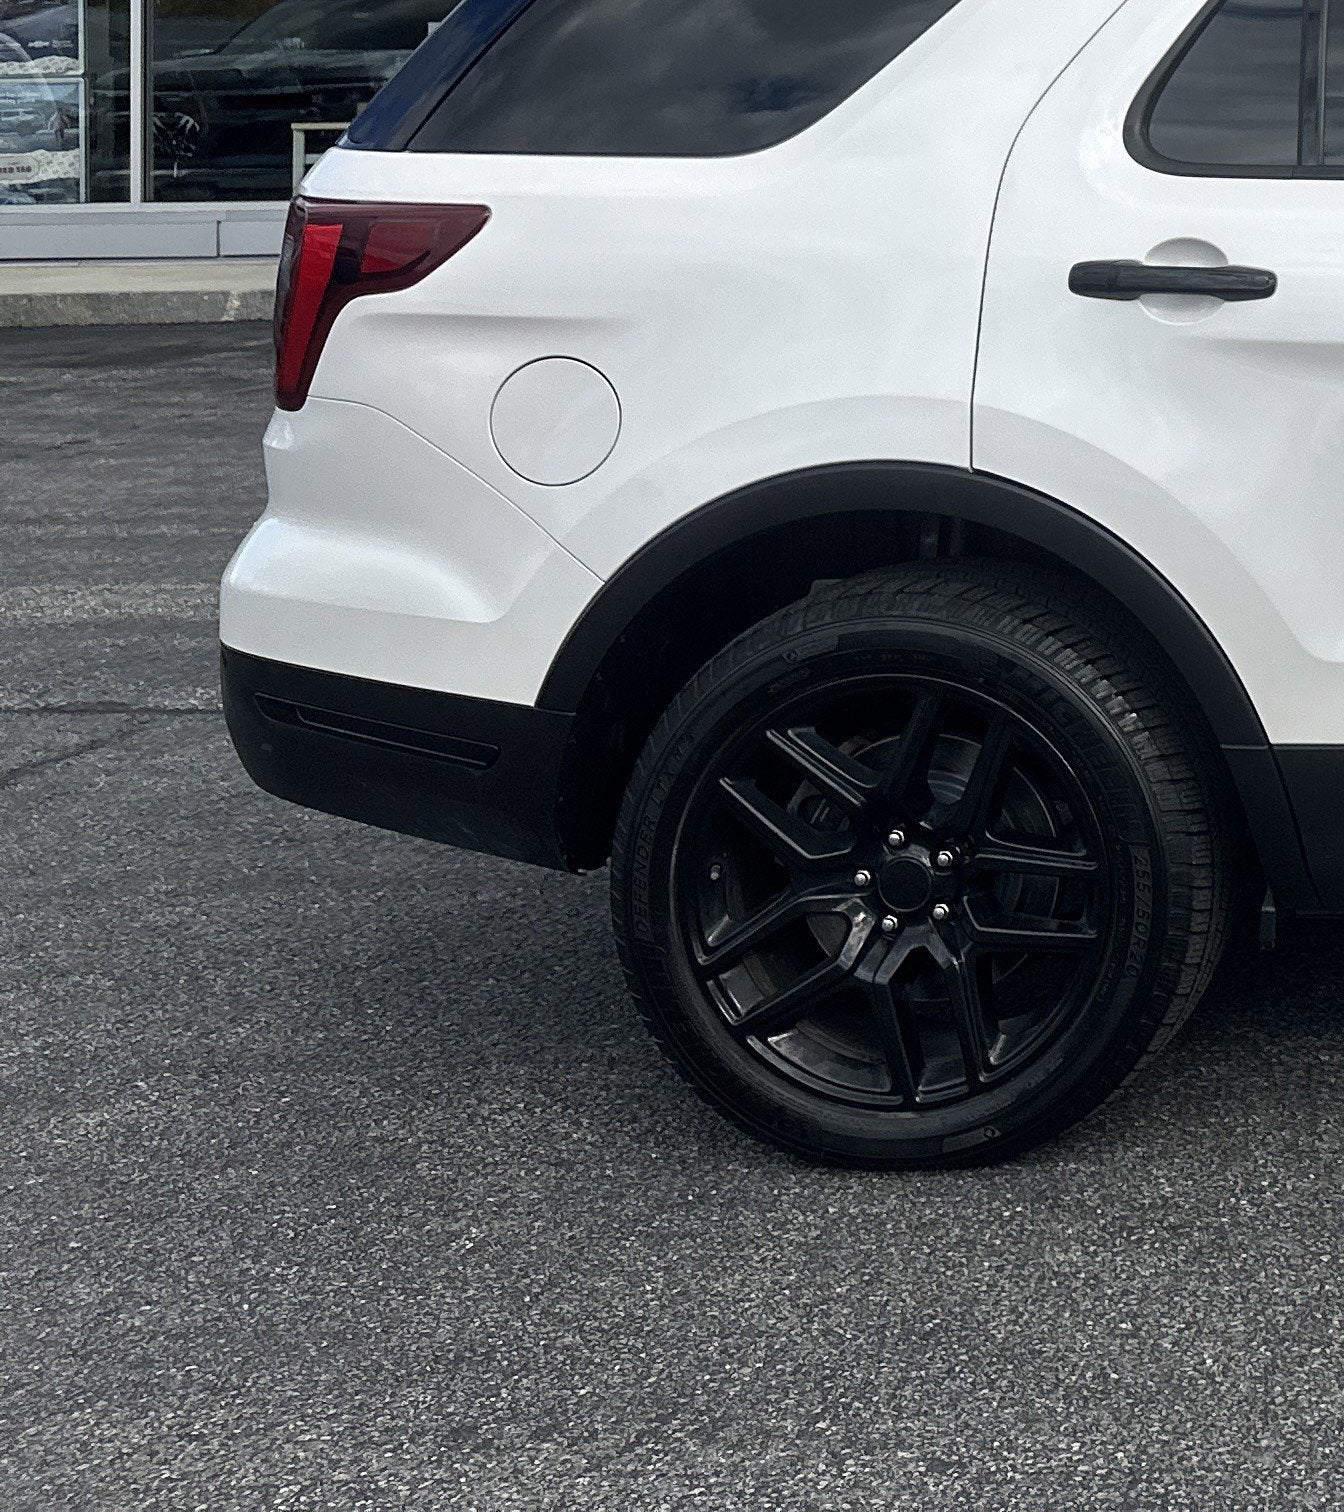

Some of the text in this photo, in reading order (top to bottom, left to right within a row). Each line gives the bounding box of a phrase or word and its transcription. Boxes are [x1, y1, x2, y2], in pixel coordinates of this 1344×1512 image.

[634, 814, 658, 935] DEFENDER
[1005, 663, 1151, 977] MICHELIN 255/50R20
